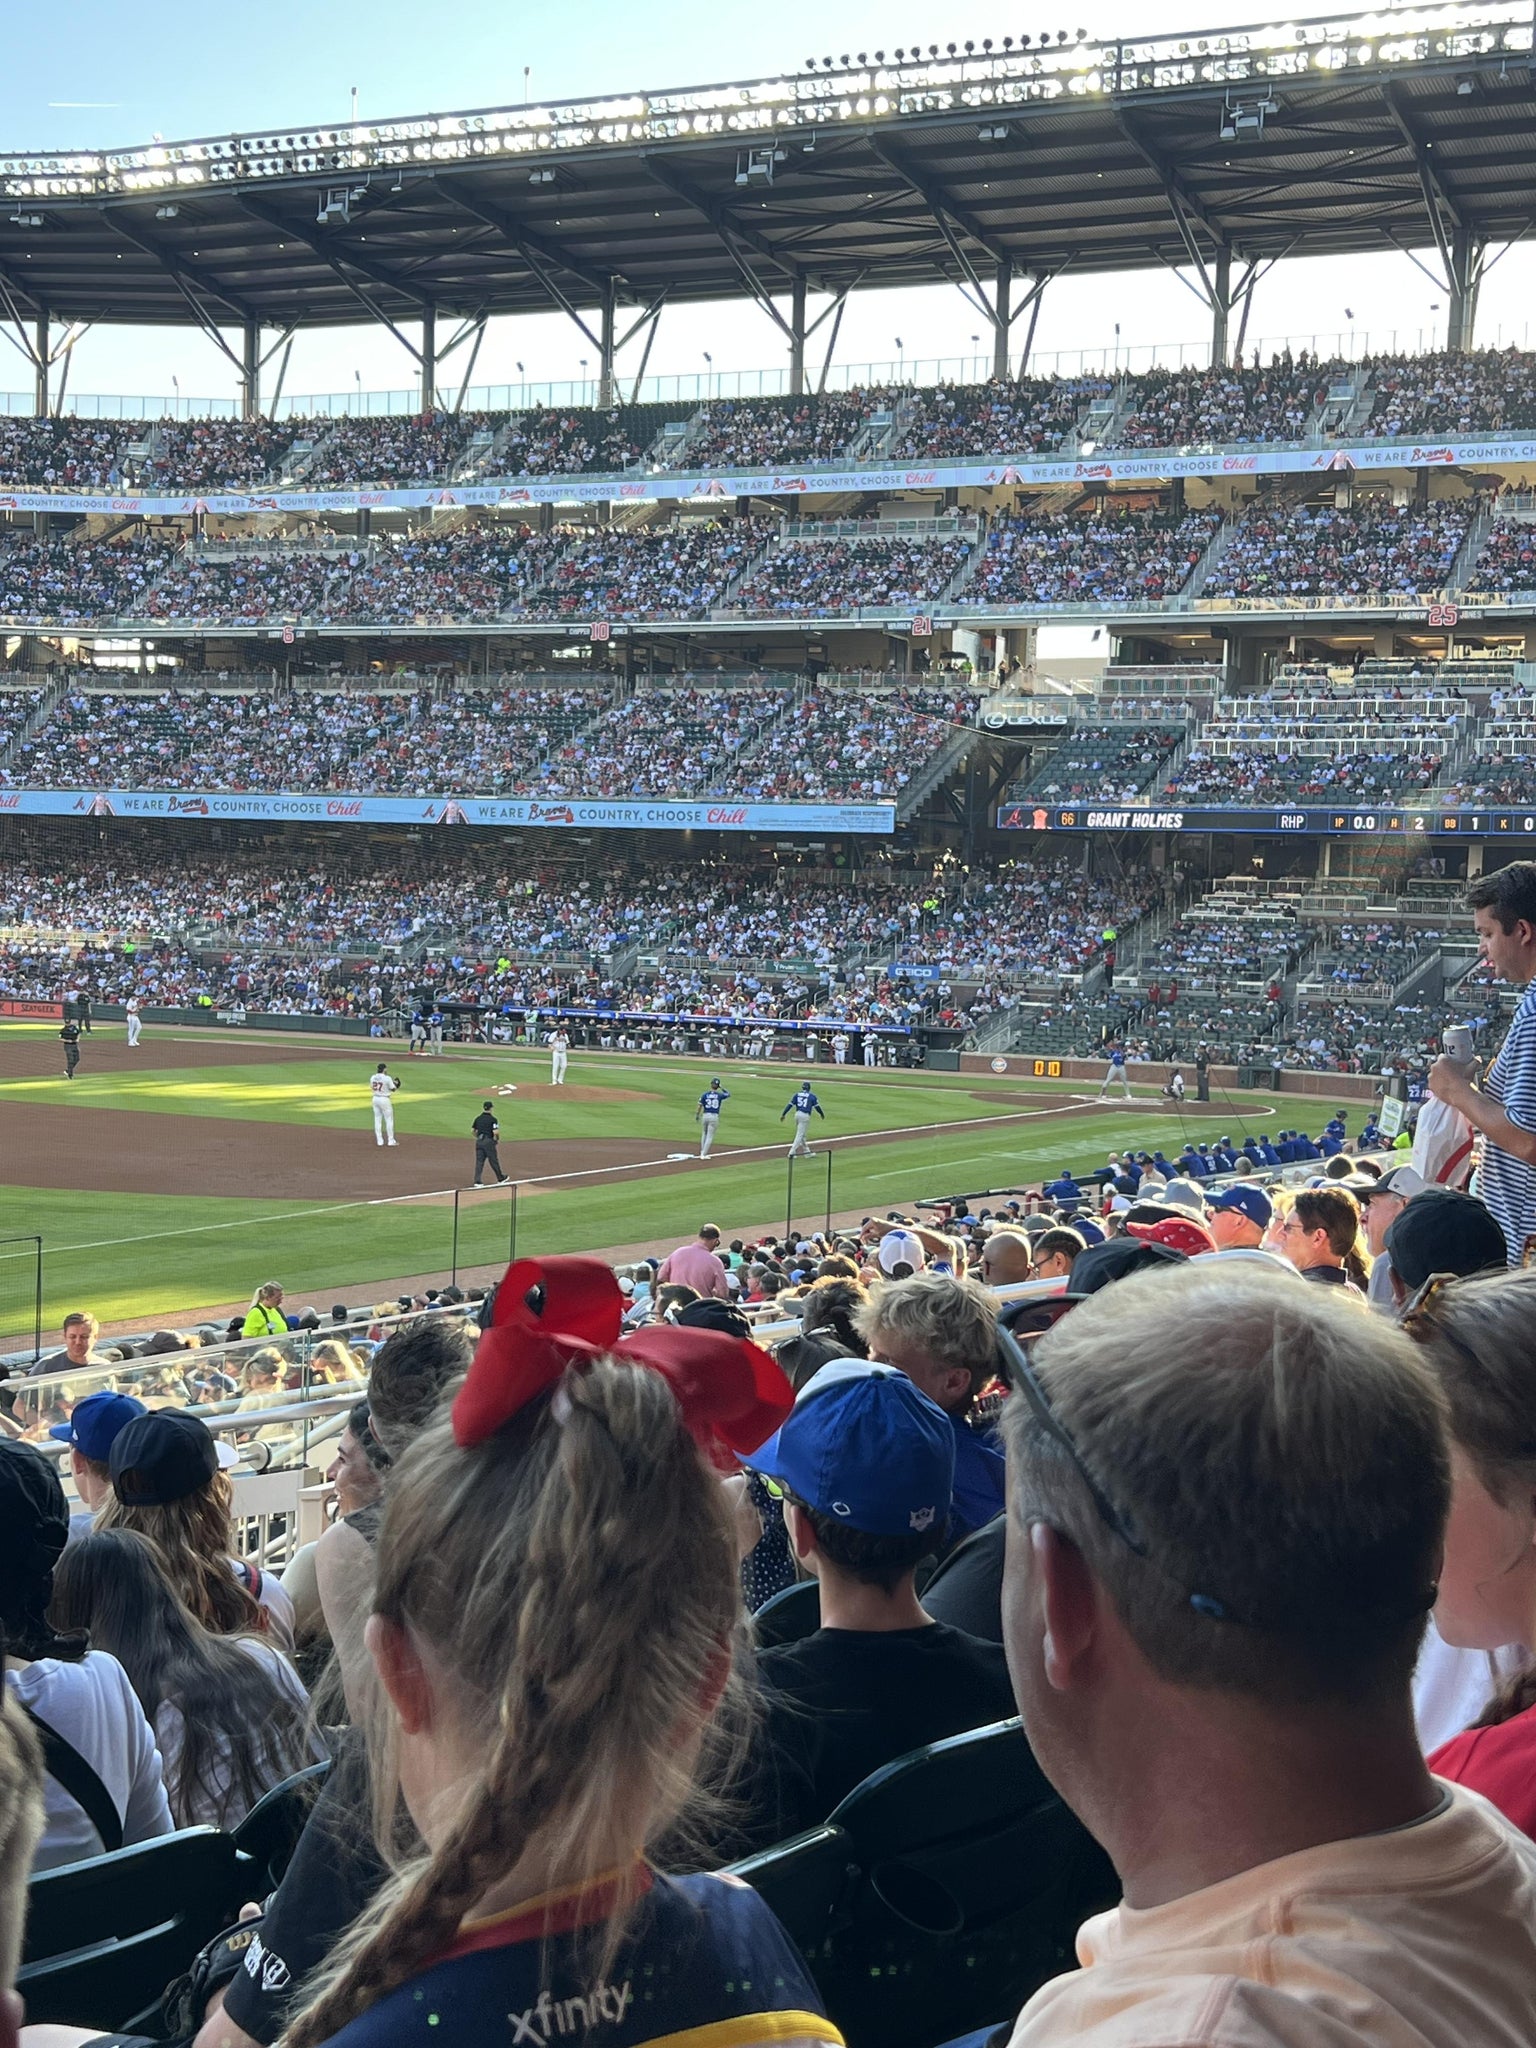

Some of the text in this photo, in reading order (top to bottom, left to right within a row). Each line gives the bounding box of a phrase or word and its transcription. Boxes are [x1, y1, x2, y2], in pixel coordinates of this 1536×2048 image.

[1365, 453, 1381, 462] WE
[1384, 452, 1406, 461] ARE
[1459, 447, 1519, 458] COUNTRY,
[1032, 468, 1048, 477] WE
[1051, 467, 1071, 477] ARE
[1117, 463, 1169, 474] COUNTRY,
[1173, 461, 1218, 471] CHOOSE
[1222, 457, 1257, 470] Chill
[734, 481, 749, 490] WE
[751, 480, 769, 489] ARE
[810, 477, 858, 488] COUNTRY,
[861, 475, 902, 485] CHOOSE
[905, 472, 936, 485] Chill
[464, 492, 478, 500] WE
[479, 491, 495, 499] ARE
[533, 488, 577, 498] COUNTRY,
[579, 487, 615, 495] CHOOSE
[619, 484, 647, 495] Chill
[70, 500, 108, 508] CHOOSE
[112, 500, 139, 509] Chill
[1428, 604, 1457, 626] 25
[590, 621, 609, 641] 10
[912, 615, 932, 636] 21
[283, 625, 295, 644] 6
[1007, 715, 1068, 725] LEXUS
[124, 799, 139, 809] WE
[143, 800, 164, 810] ARE
[213, 801, 270, 814] COUNTRY,
[273, 803, 322, 814] CHOOSE
[326, 800, 362, 816] Chill
[478, 807, 496, 818] WE
[500, 807, 524, 819] ARE
[579, 809, 643, 822] COUNTRY,
[647, 810, 701, 822] CHOOSE
[707, 807, 748, 824] Chill
[1061, 812, 1184, 829] 66 GRANT HOLMES
[1281, 815, 1534, 831] RHP IP 0.0 H 2 BB 1 K 0
[895, 968, 932, 976] GEICO
[372, 1081, 383, 1092] 27
[507, 1980, 630, 2046] xfinity
